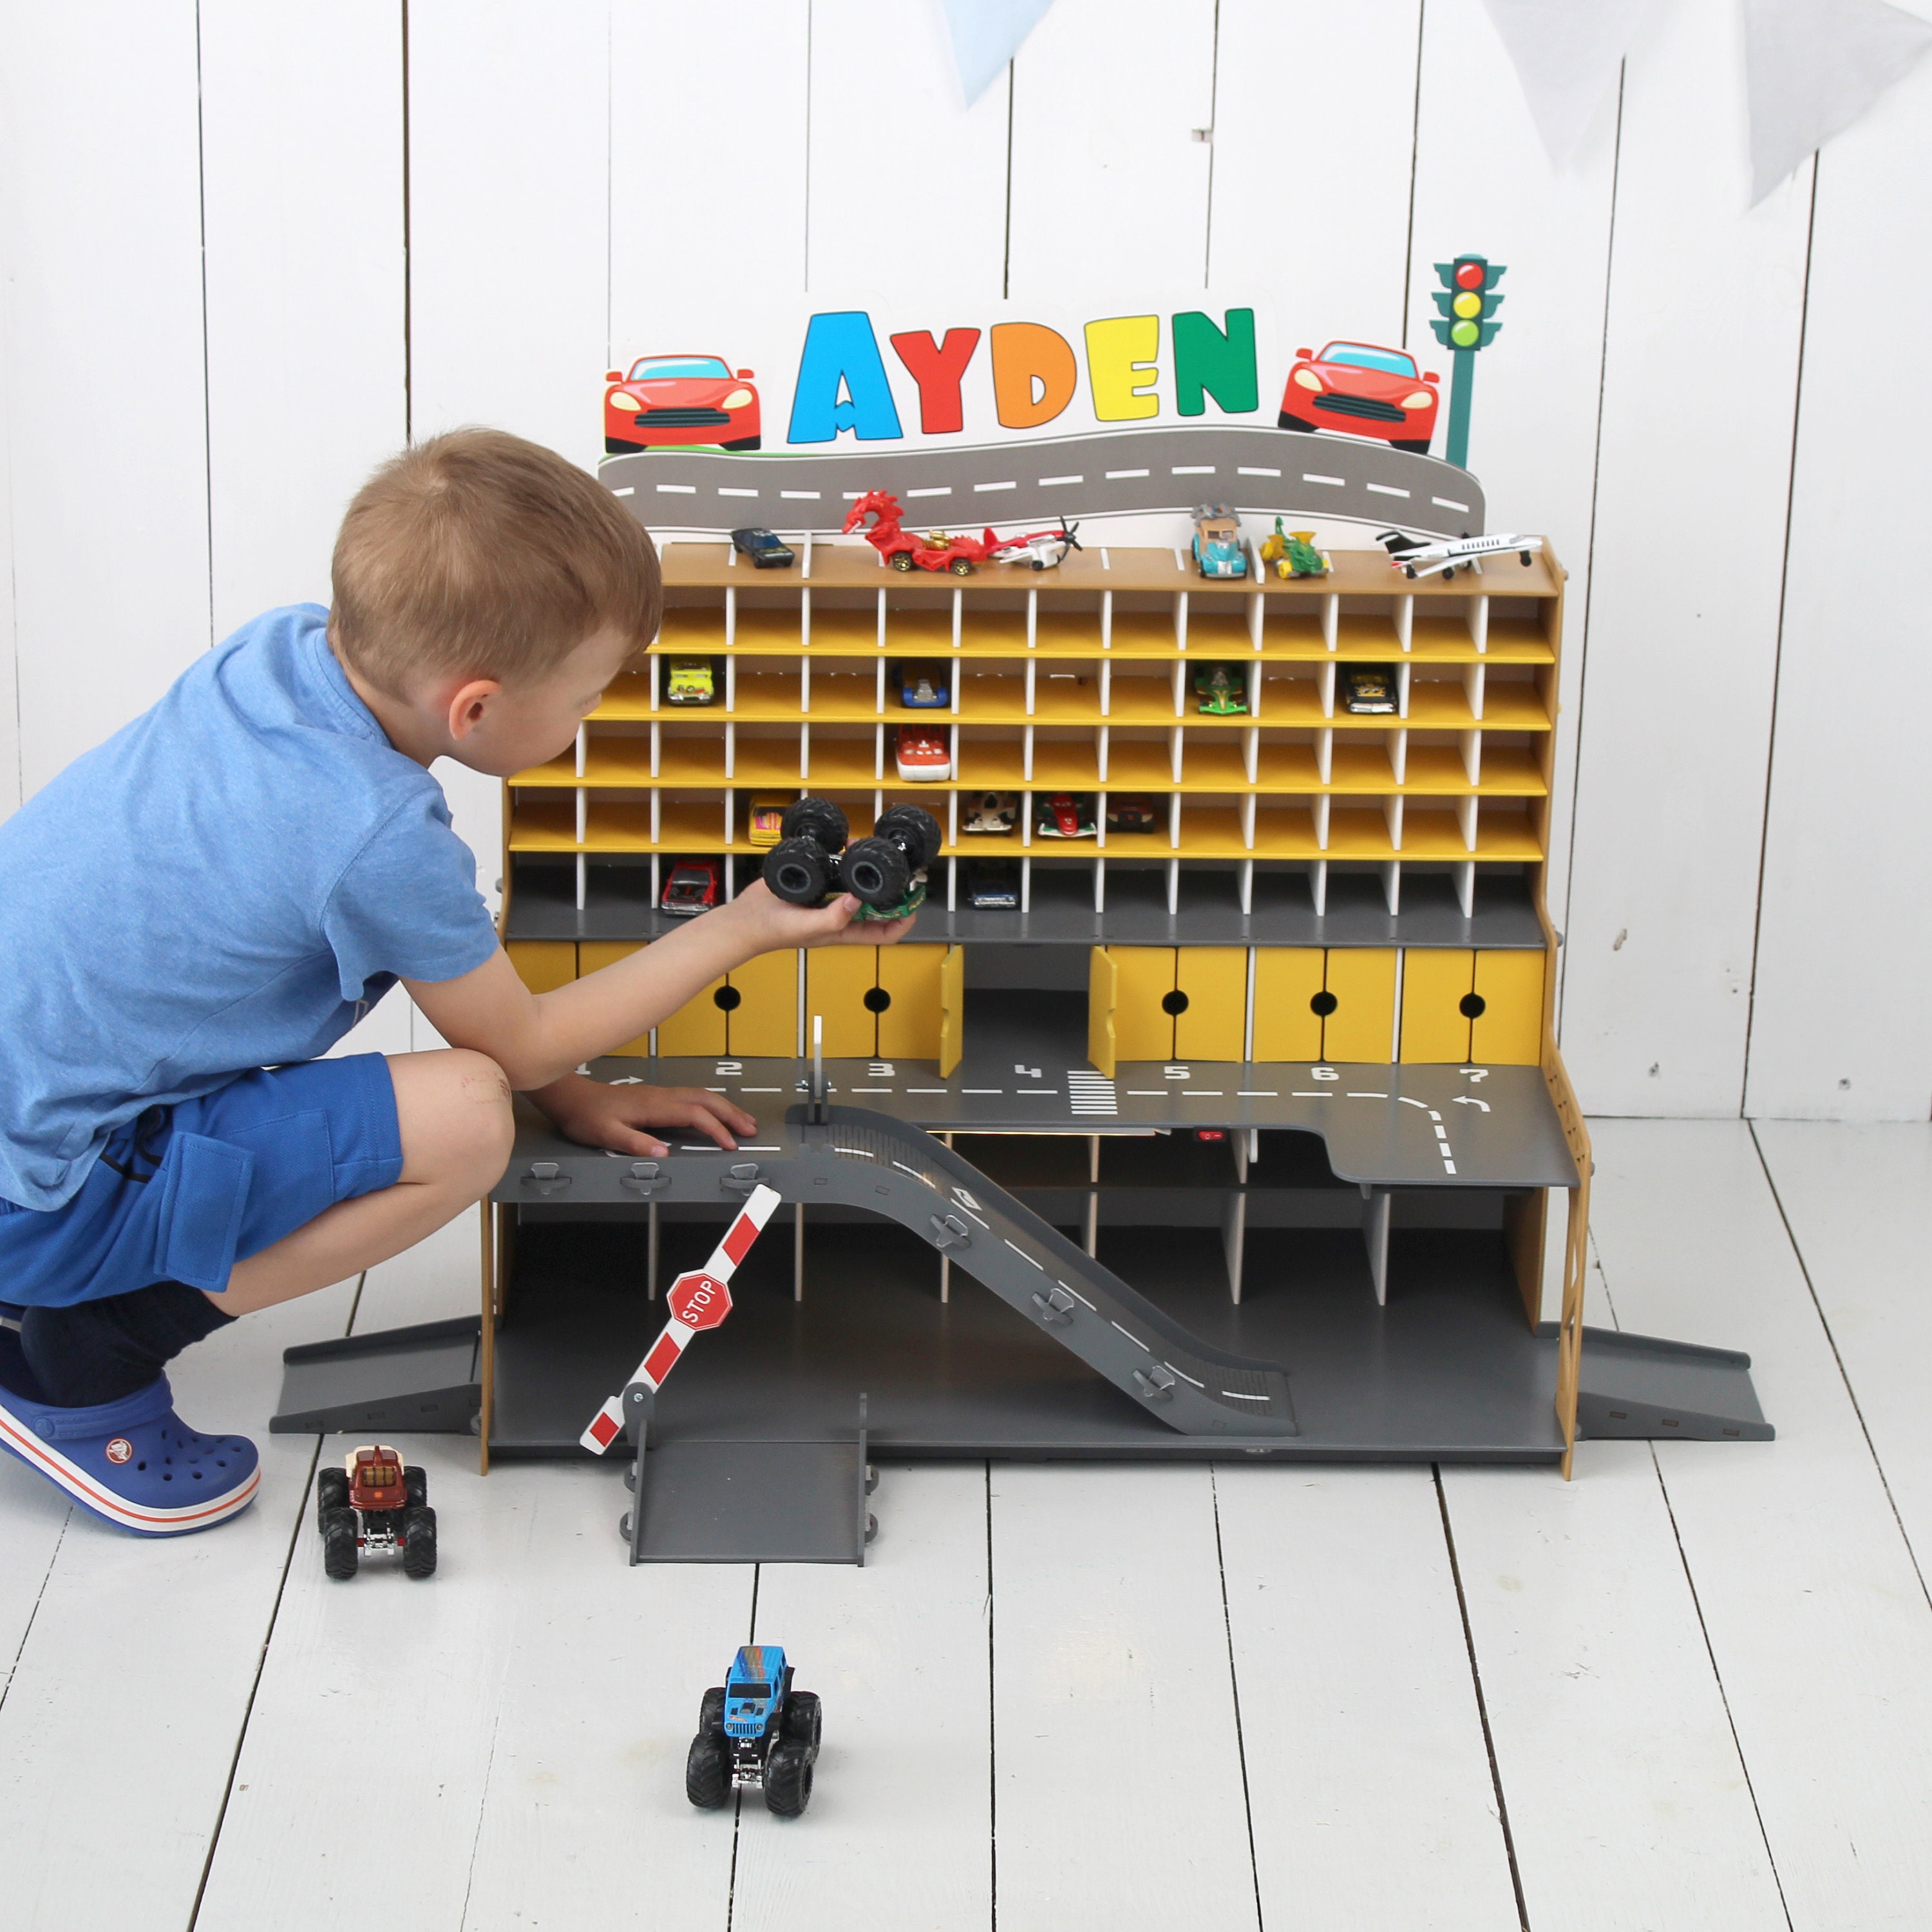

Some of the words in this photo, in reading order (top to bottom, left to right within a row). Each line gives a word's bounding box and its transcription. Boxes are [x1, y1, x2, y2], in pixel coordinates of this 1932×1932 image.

[788, 308, 1258, 444] AYDEN
[715, 1062, 743, 1075] 2
[868, 1063, 895, 1076] 3
[1015, 1065, 1041, 1078] 4
[1164, 1066, 1191, 1079] 5
[1312, 1066, 1340, 1081] 6
[1459, 1069, 1488, 1083] 7
[682, 1280, 715, 1323] STOP
